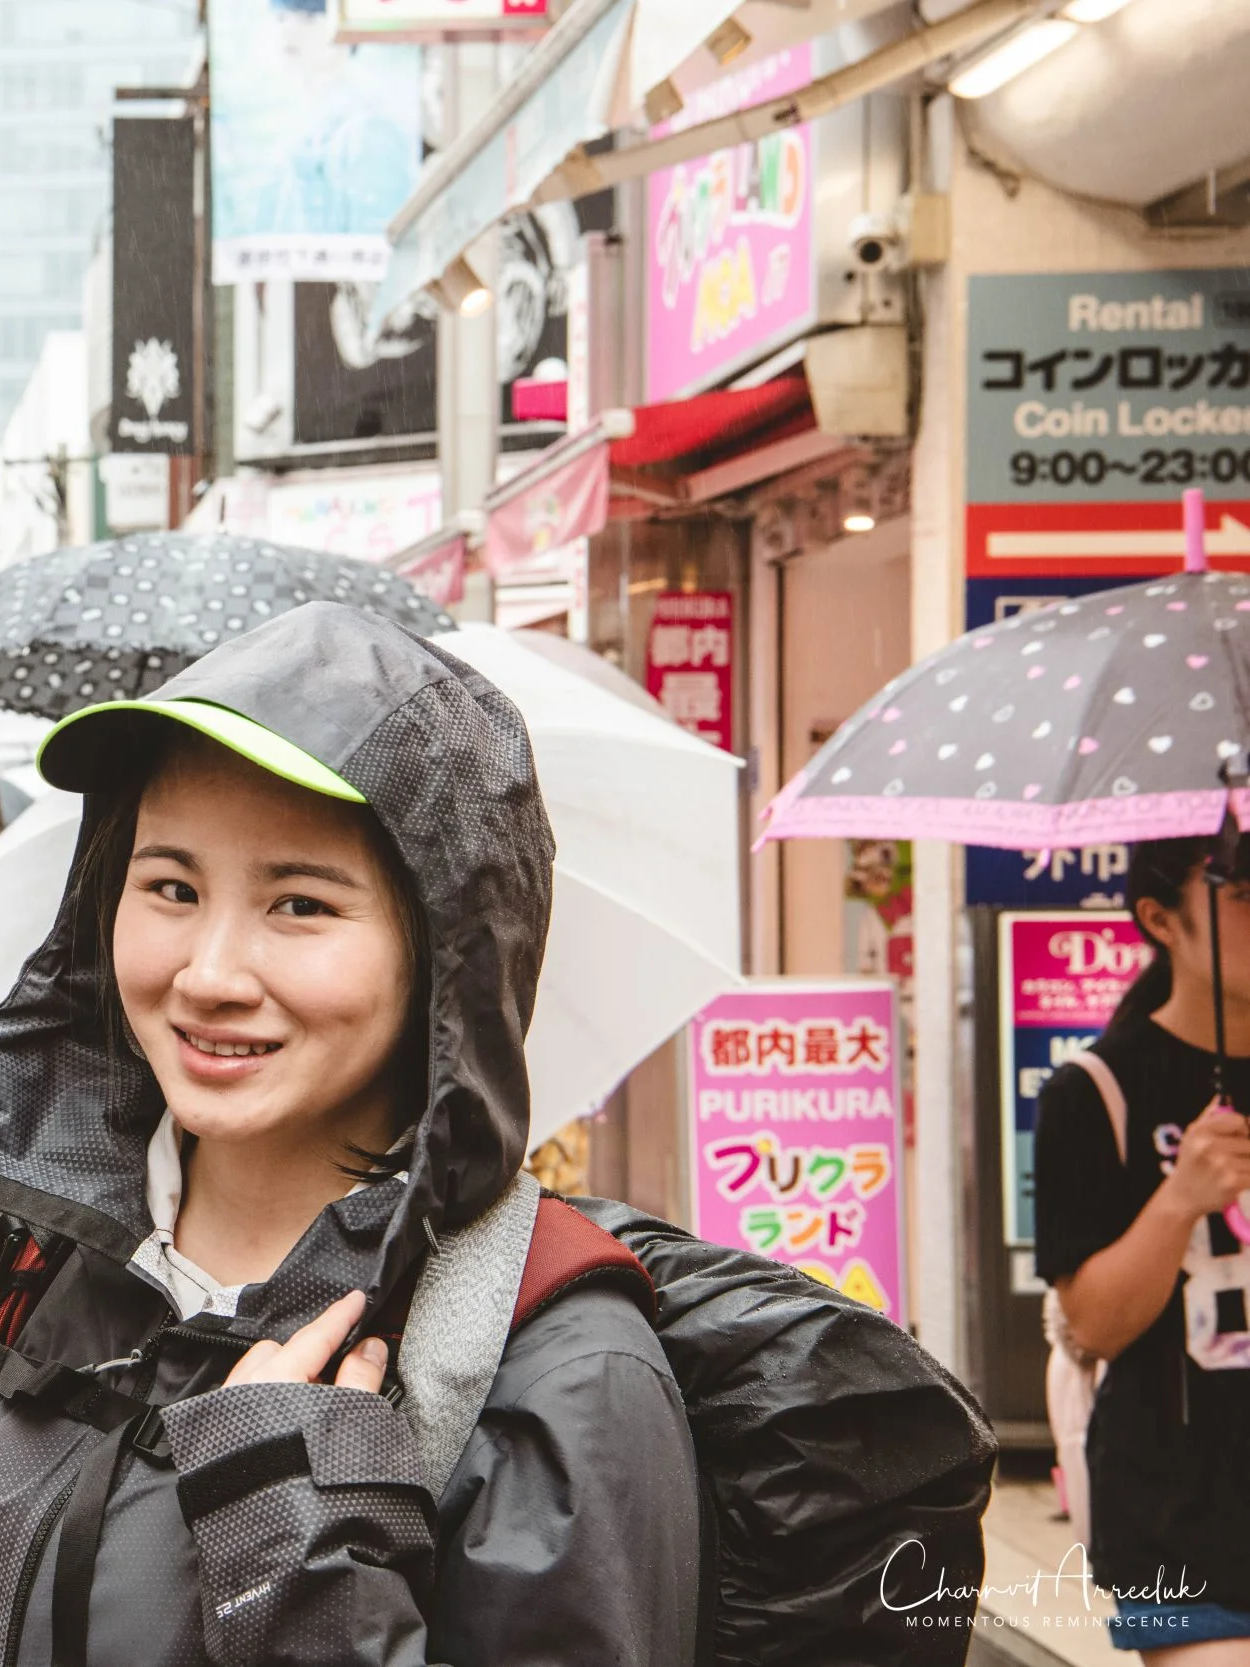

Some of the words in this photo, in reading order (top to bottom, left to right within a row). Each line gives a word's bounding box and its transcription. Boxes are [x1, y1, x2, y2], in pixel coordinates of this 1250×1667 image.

[1068, 293, 1204, 331] Rental
[982, 342, 1250, 391] コインロッカ
[1014, 400, 1110, 438] Coin
[708, 1021, 885, 1071] 都内最大
[700, 1087, 894, 1123] PURIKURA
[711, 1137, 888, 1194] プリクラ
[746, 1205, 860, 1250] ランド
[235, 1581, 271, 1608] HYVENT
